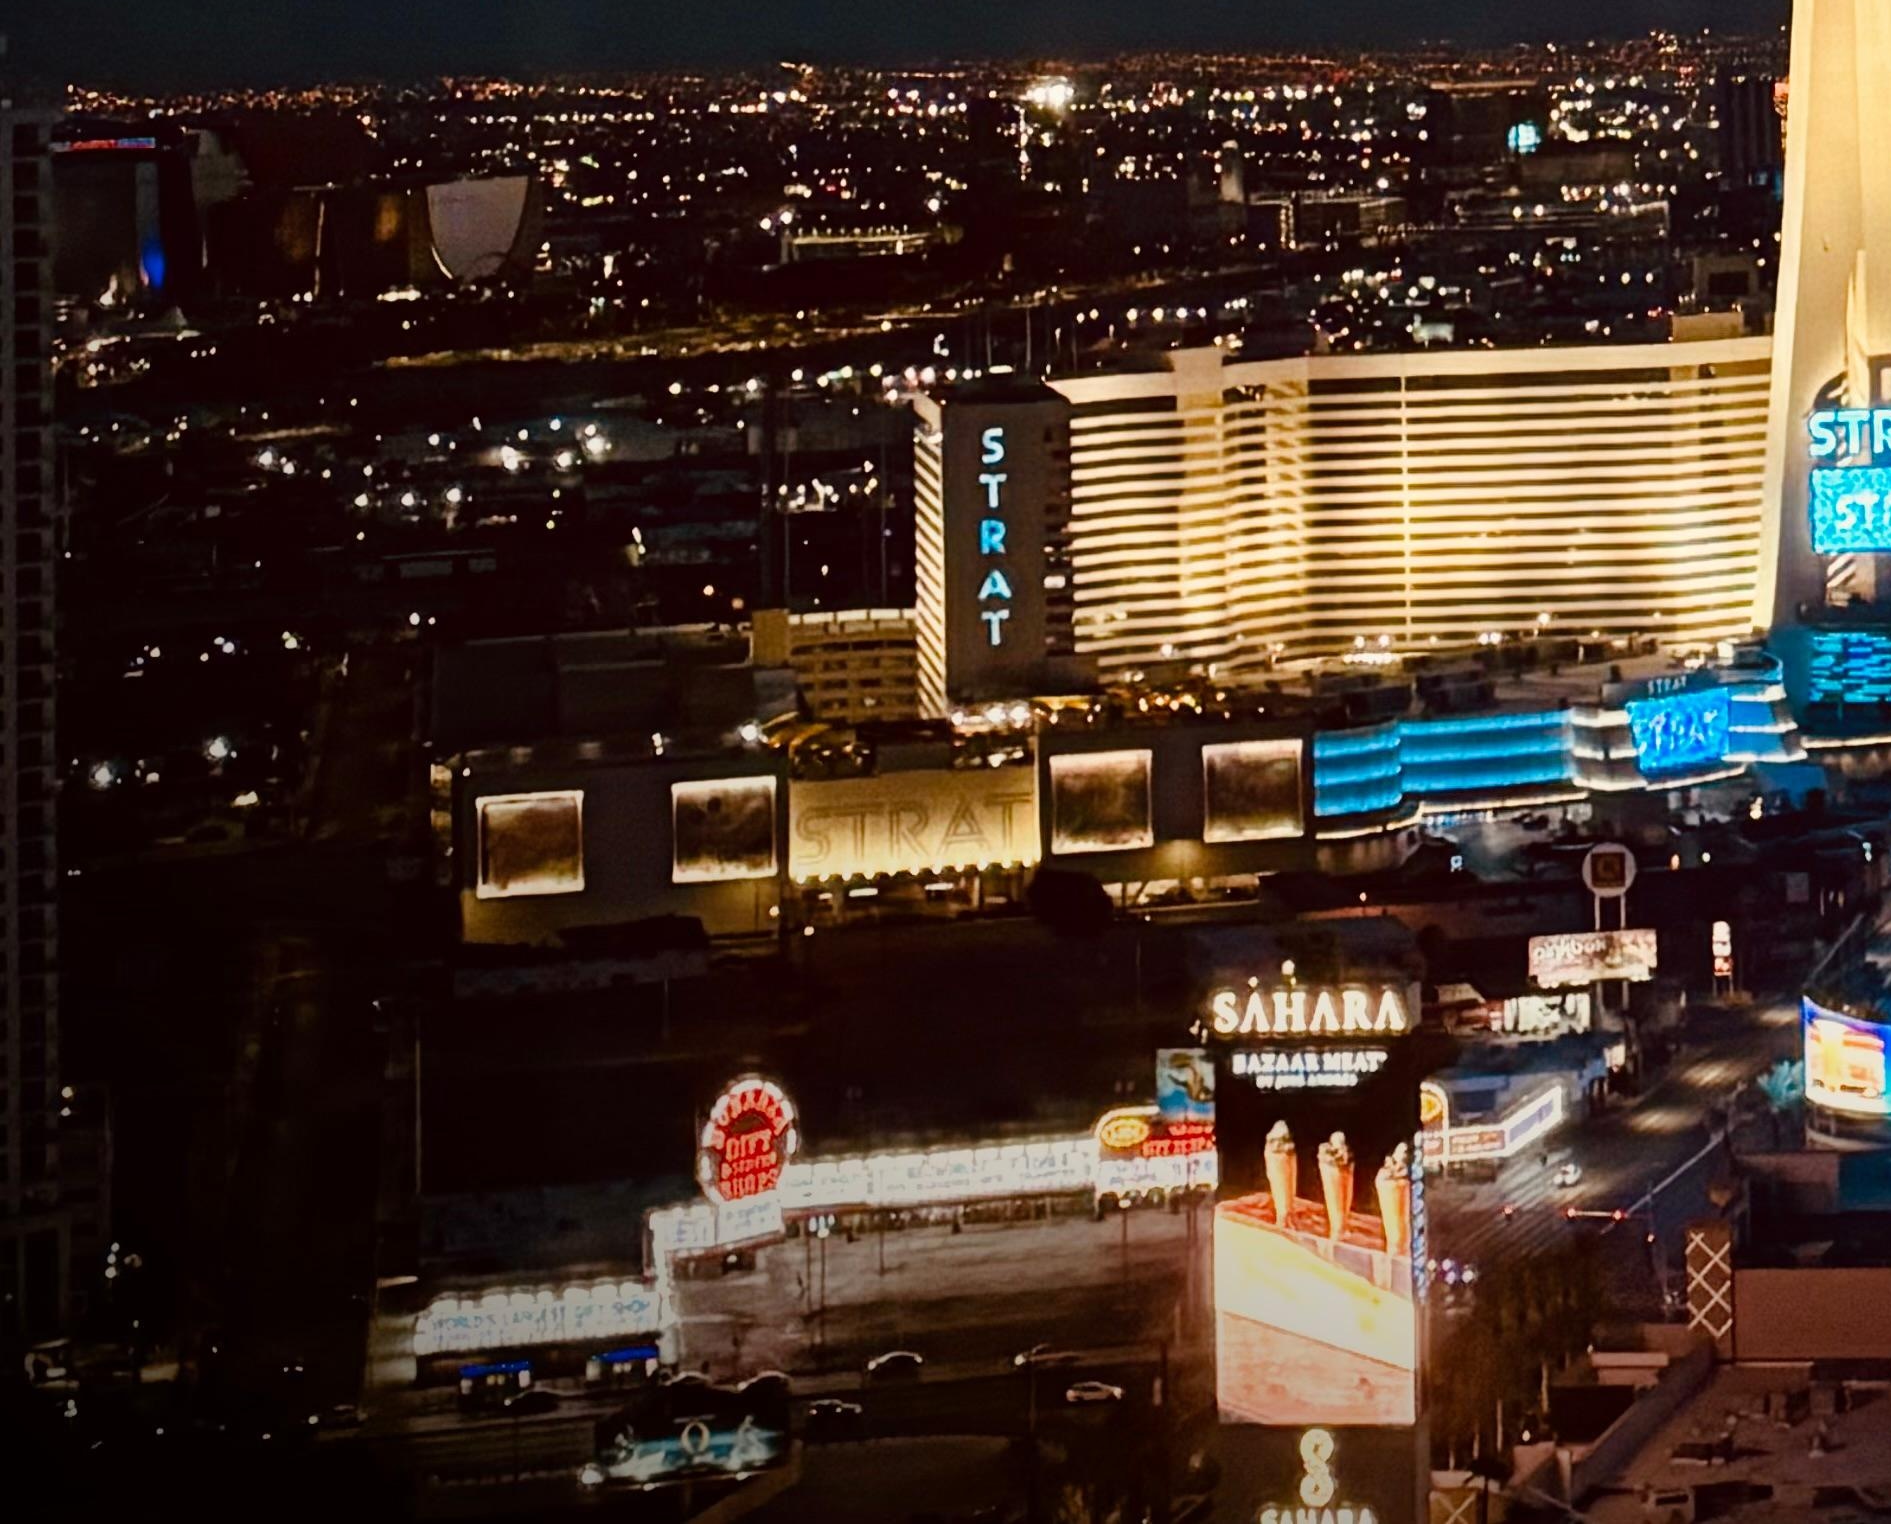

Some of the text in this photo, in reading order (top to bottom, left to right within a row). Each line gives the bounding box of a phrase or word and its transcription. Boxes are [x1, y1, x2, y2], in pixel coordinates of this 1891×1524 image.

[977, 427, 1012, 646] STRAT
[1647, 676, 1687, 695] STRAT
[796, 792, 1034, 865] STRAT
[1213, 989, 1406, 1034] SAHARA
